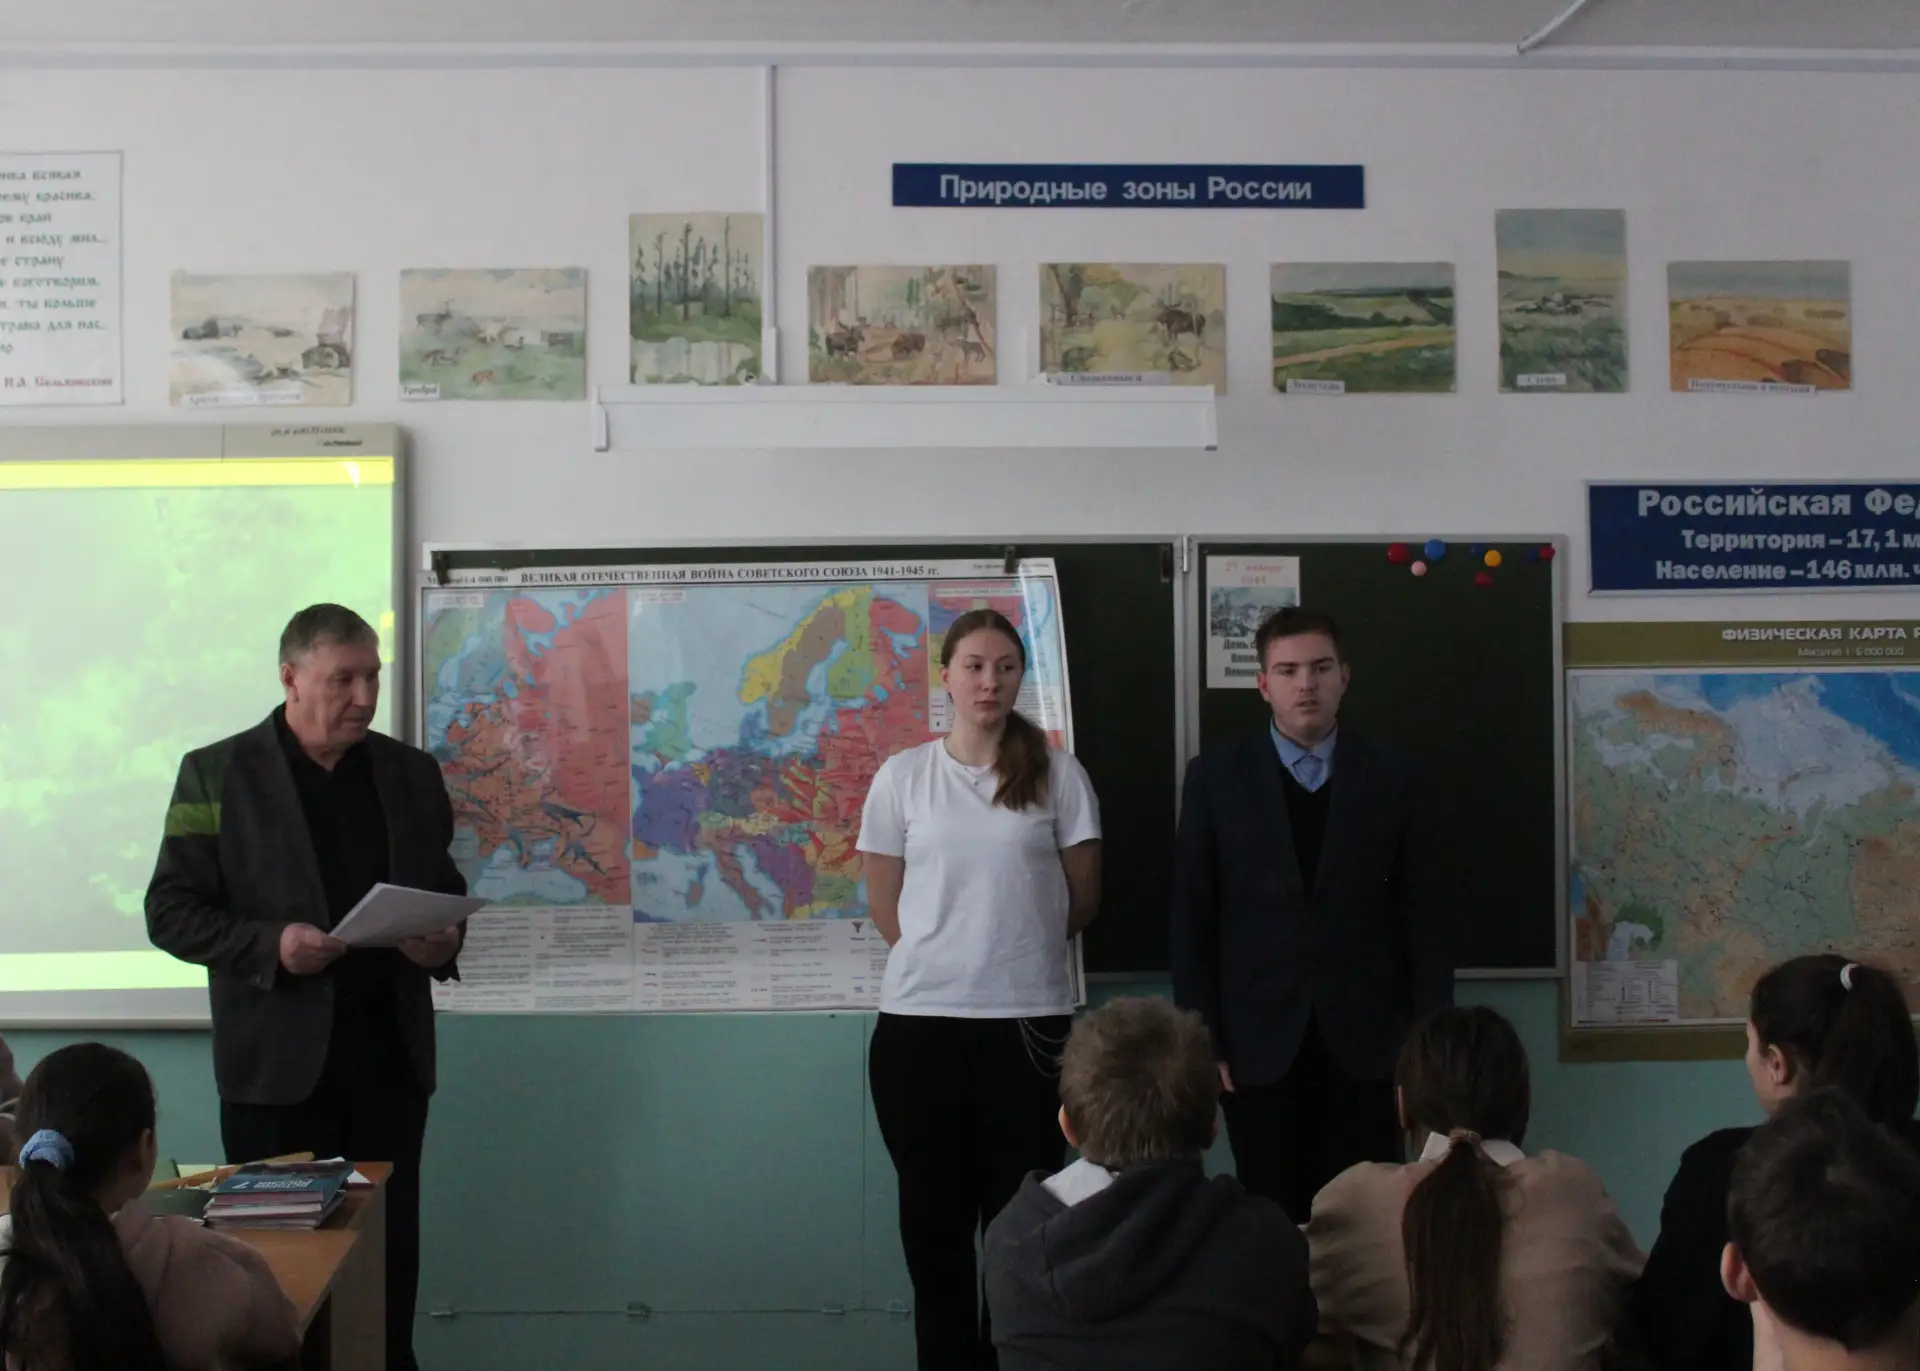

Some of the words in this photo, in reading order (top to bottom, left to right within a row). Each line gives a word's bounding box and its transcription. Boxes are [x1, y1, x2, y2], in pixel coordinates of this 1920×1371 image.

[940, 173, 1108, 204] Природные
[1122, 181, 1196, 200] зоны
[1207, 175, 1312, 200] России
[1638, 487, 1851, 517] Российская
[1681, 529, 1826, 552] Территория
[521, 572, 578, 584] ВЕЛИКАЯ
[581, 569, 687, 582] ОТЕЧЕСТВЕННАЯ
[690, 567, 735, 580] ВОЙНА
[737, 567, 821, 579] СОВЕТСКОГО
[823, 566, 868, 577] СОЮЗА
[871, 565, 925, 577] 1941-1945
[1655, 560, 1787, 580] Население
[1806, 559, 1852, 580] 146
[1854, 563, 1910, 579] млн.
[1721, 627, 1842, 641] ФИЗИЧЕСКАЯ
[1848, 627, 1907, 640] КАРТА
